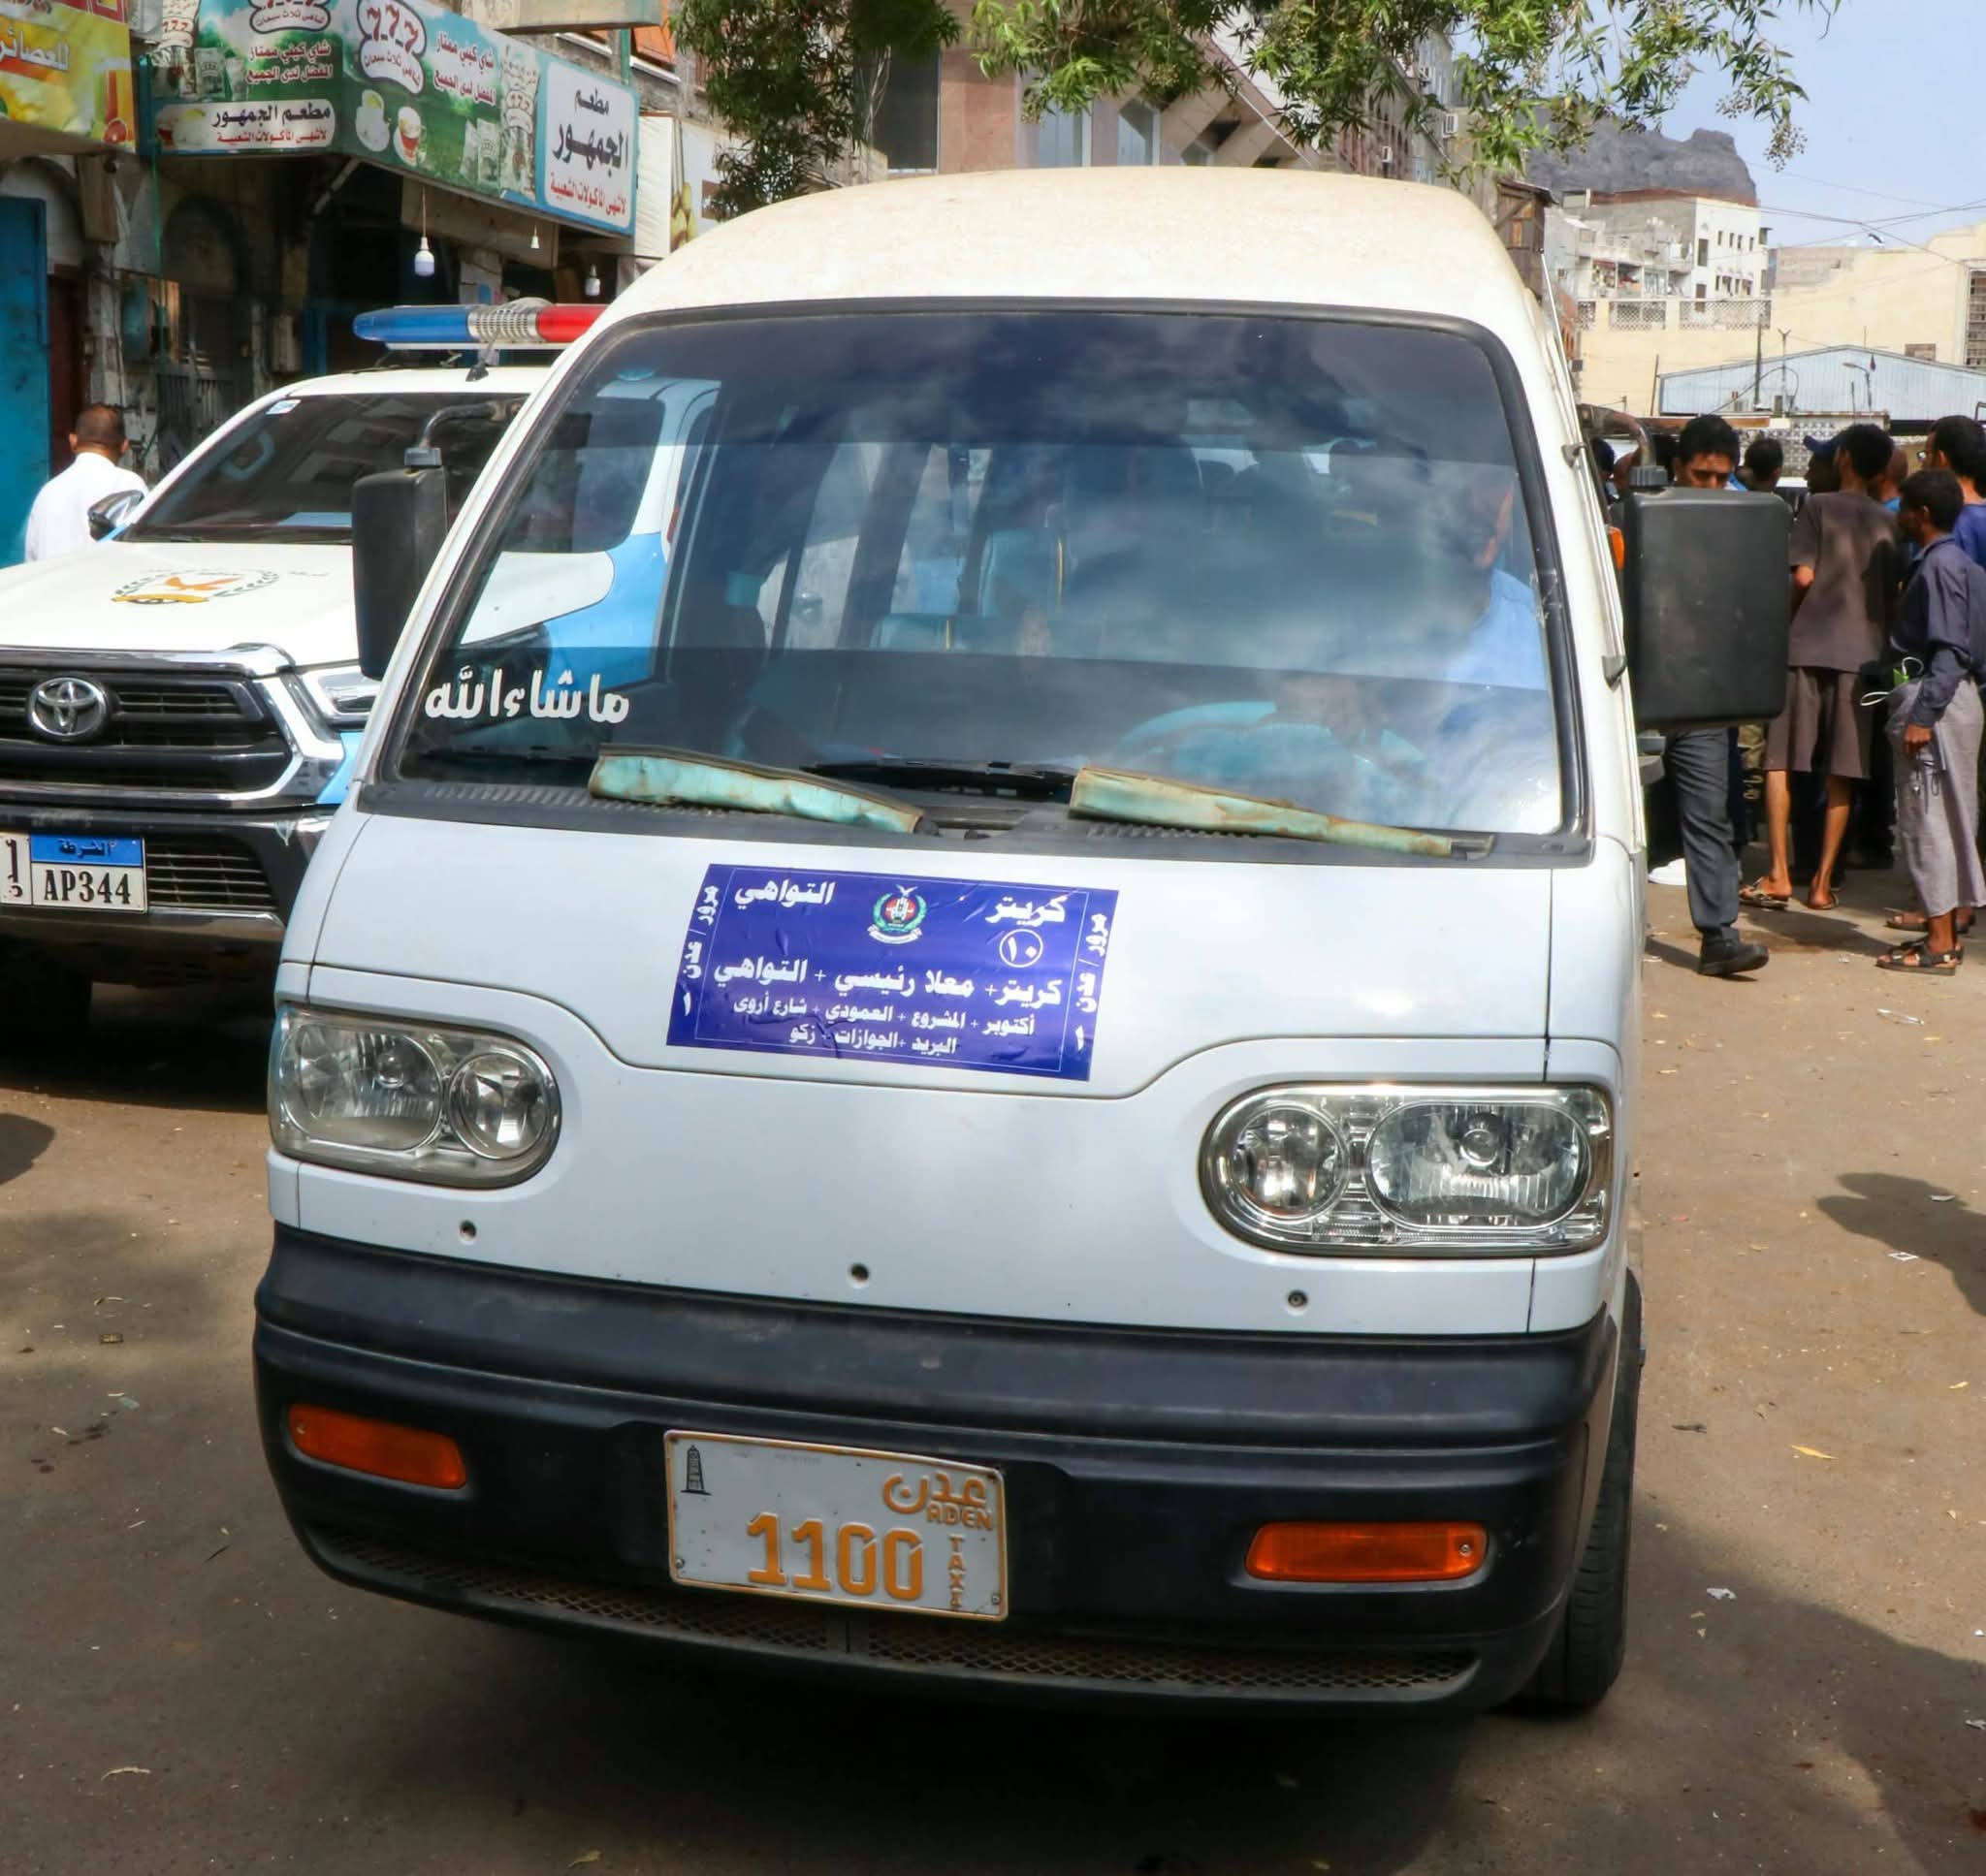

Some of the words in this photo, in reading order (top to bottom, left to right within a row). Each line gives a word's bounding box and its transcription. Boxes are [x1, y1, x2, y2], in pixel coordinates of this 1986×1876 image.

[282, 102, 330, 124] مطعم
[575, 87, 609, 115] مطعم
[211, 104, 277, 127] الجمهور
[552, 124, 628, 177] الجمهور
[57, 839, 112, 859] الشرطة
[44, 869, 131, 905] AP344
[734, 879, 836, 909] التواهي
[983, 893, 1070, 928] كريتر
[1007, 936, 1038, 963] ١٠
[714, 956, 808, 988] التواهي
[834, 965, 916, 998] رئيسي
[924, 970, 976, 999] معلا
[733, 991, 770, 1015] أروى
[772, 998, 808, 1017] شارع
[824, 1004, 894, 1024] العمودي
[789, 1023, 816, 1045] زكو
[911, 1010, 967, 1031] المشروع
[981, 1013, 1036, 1037] أكتوبر
[911, 1036, 958, 1057] البريد
[882, 1472, 987, 1515] عدن
[927, 1503, 994, 1531] ADEN
[746, 1511, 924, 1601] 1100
